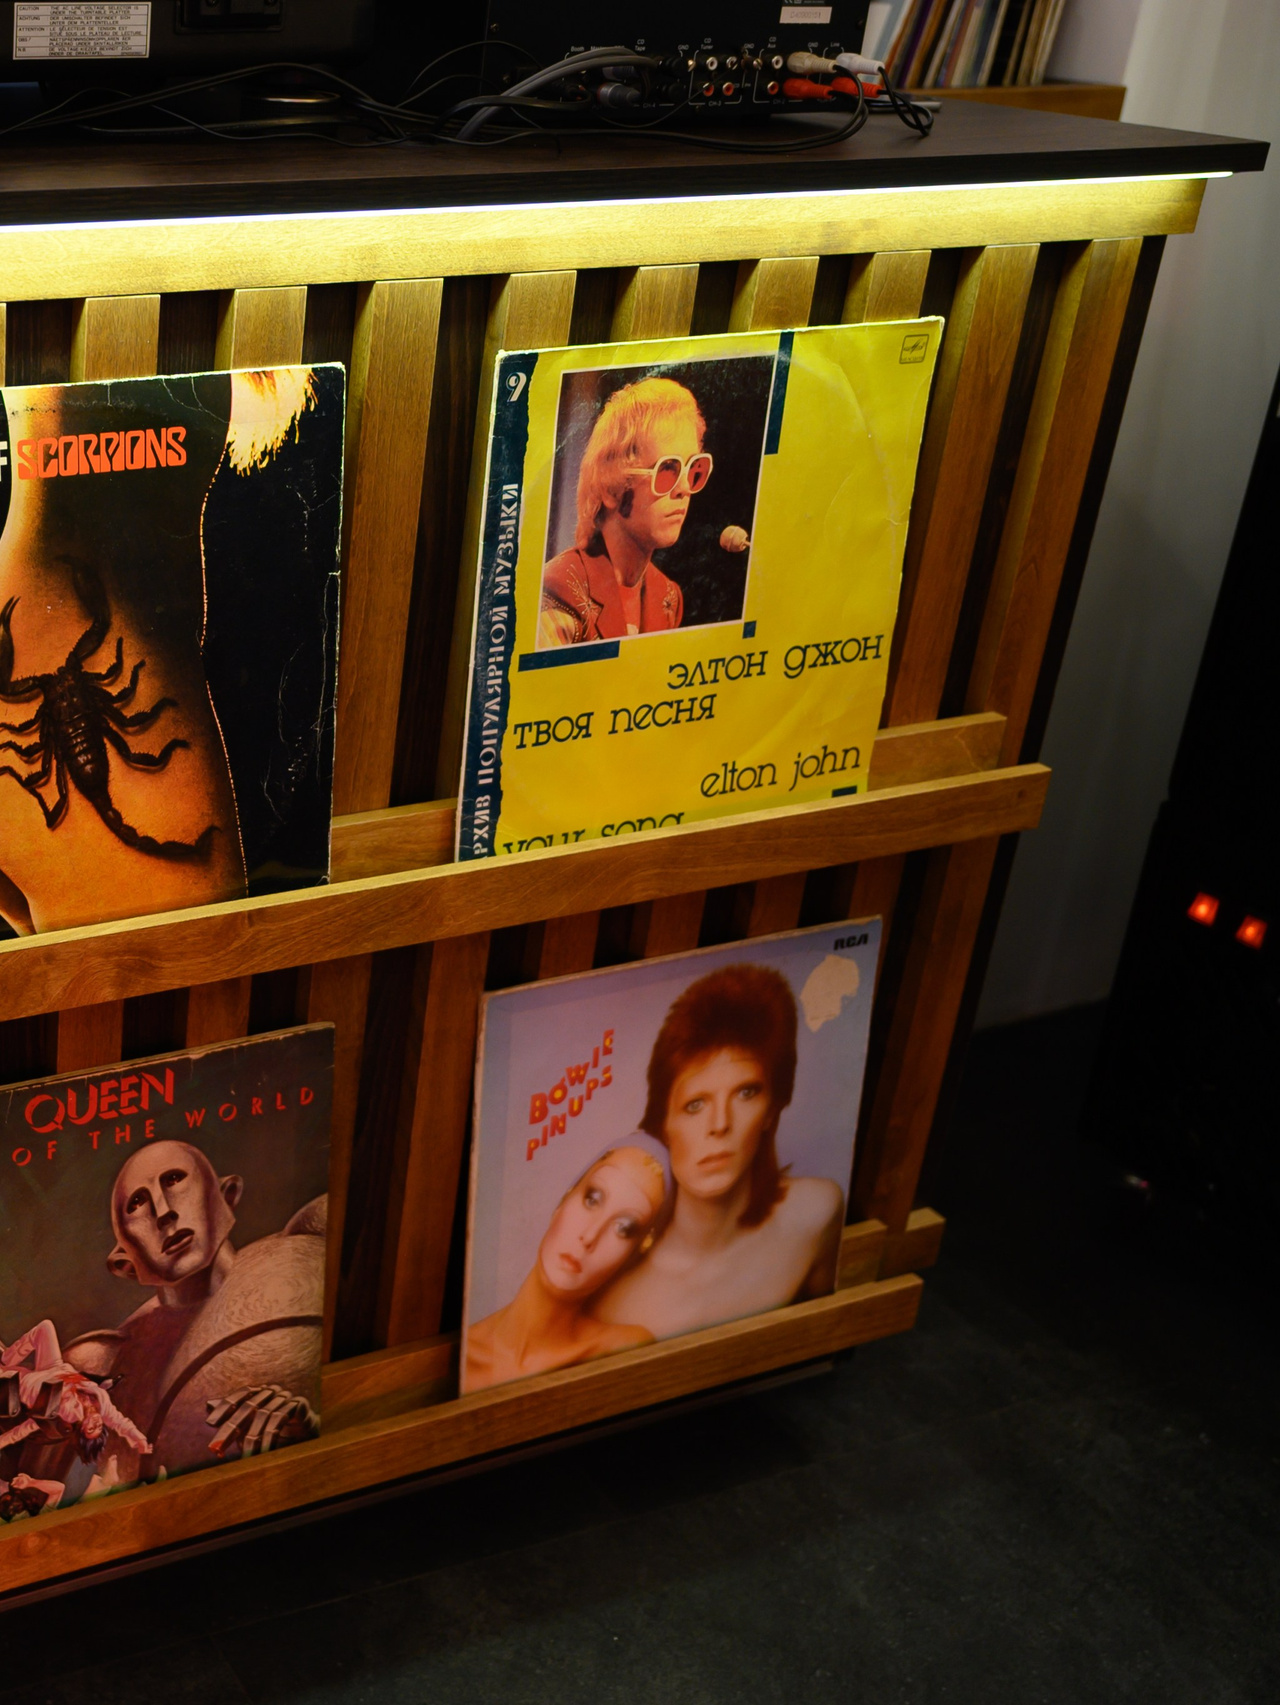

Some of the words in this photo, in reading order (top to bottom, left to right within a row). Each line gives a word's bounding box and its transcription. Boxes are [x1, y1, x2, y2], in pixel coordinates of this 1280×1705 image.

[505, 371, 527, 403] 9
[17, 426, 187, 480] SCORPIONS
[493, 483, 519, 596] МУЗЫКИ
[478, 605, 509, 785] ПОПУЛЯРНОЙ
[700, 759, 779, 798] elton
[788, 744, 862, 792] john
[473, 794, 491, 858] РХИВ
[833, 933, 869, 951] RCA
[23, 1066, 176, 1134] QUEEN
[528, 1028, 615, 1125] BOWIE
[11, 1140, 58, 1167] OF
[87, 1118, 157, 1151] THE
[184, 1085, 316, 1130] WORLD
